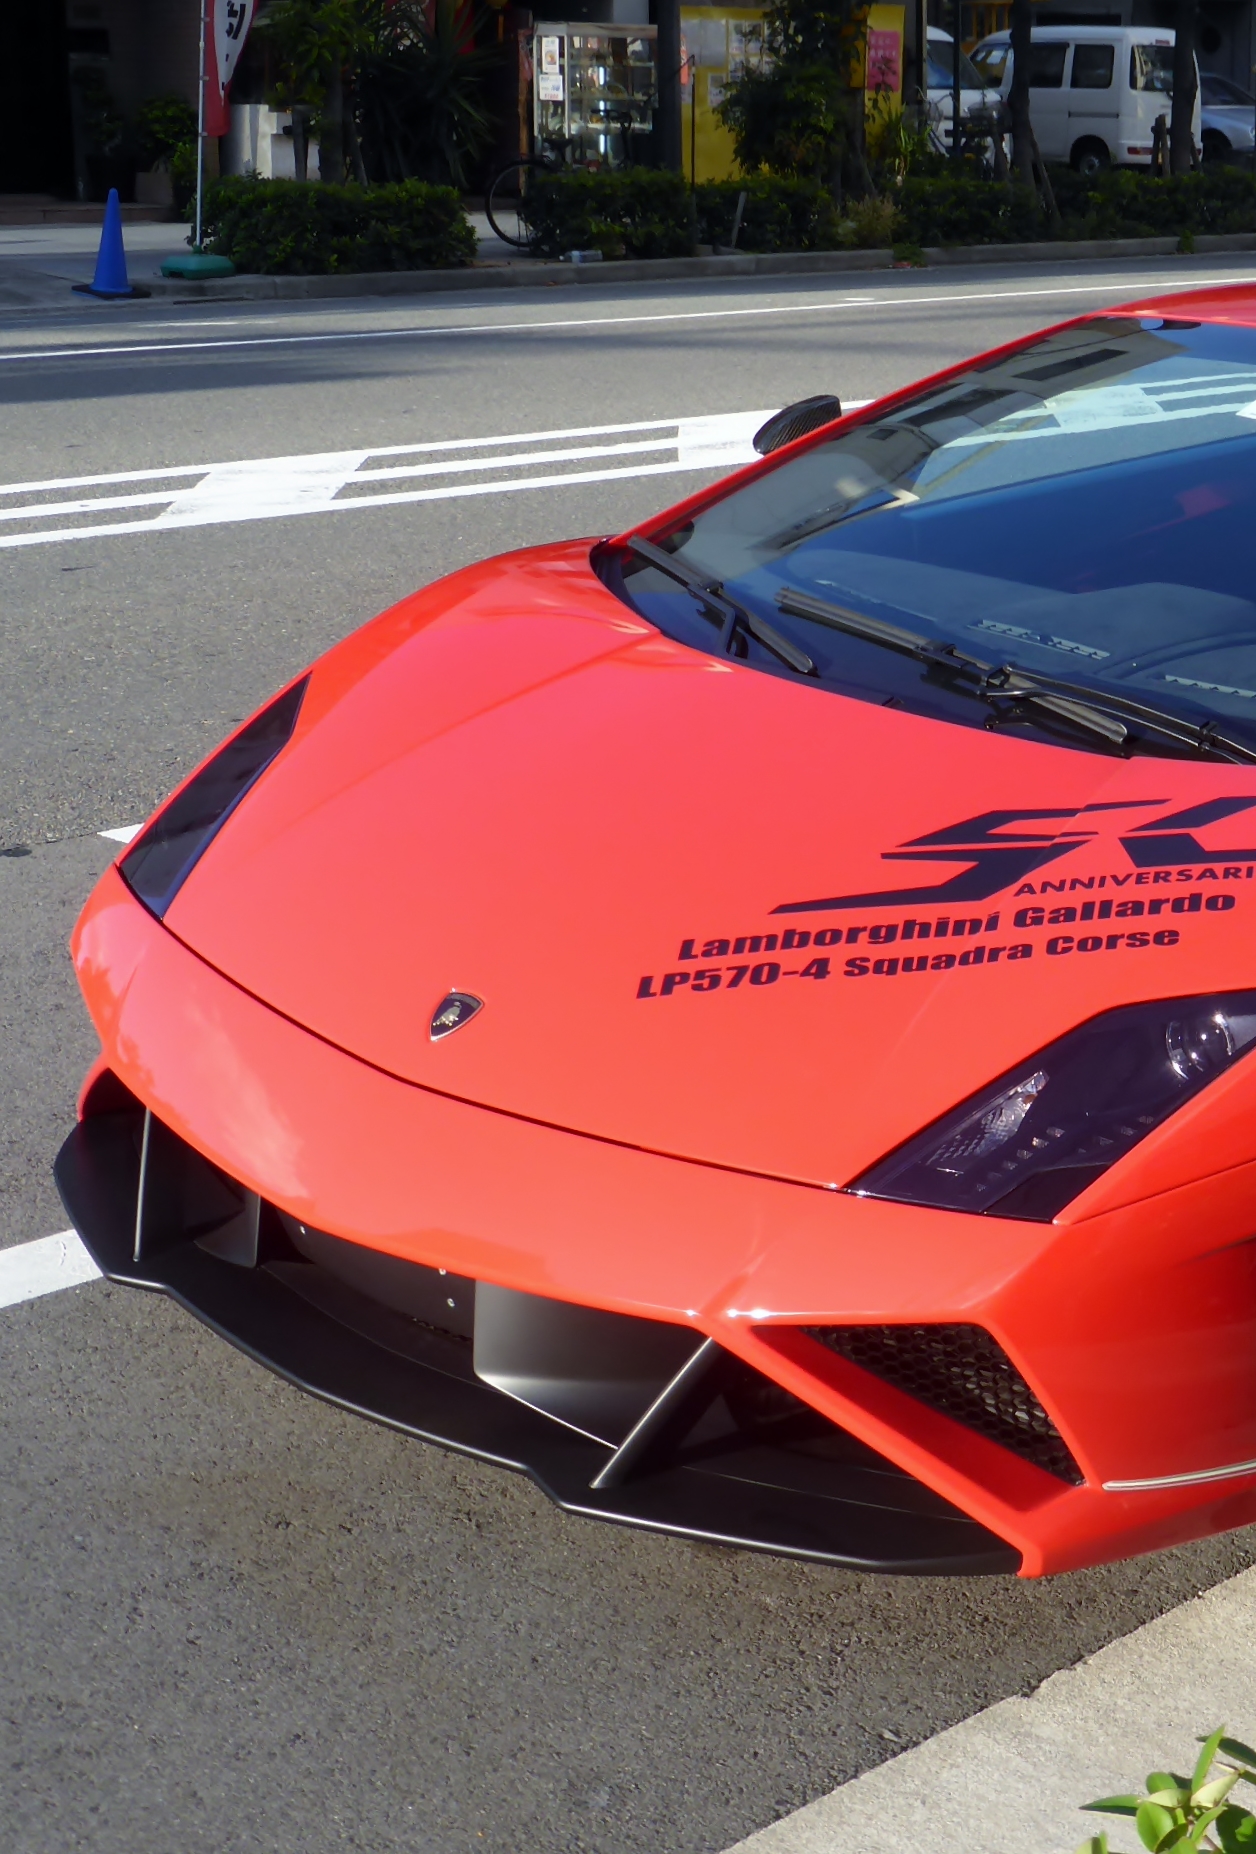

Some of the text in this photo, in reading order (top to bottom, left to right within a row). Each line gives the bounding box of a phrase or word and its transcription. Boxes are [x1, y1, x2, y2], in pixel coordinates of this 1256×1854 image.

[678, 892, 1237, 961] Lamborghini Gallardo
[636, 929, 1181, 1000] LP570-4 Squadra Corse
